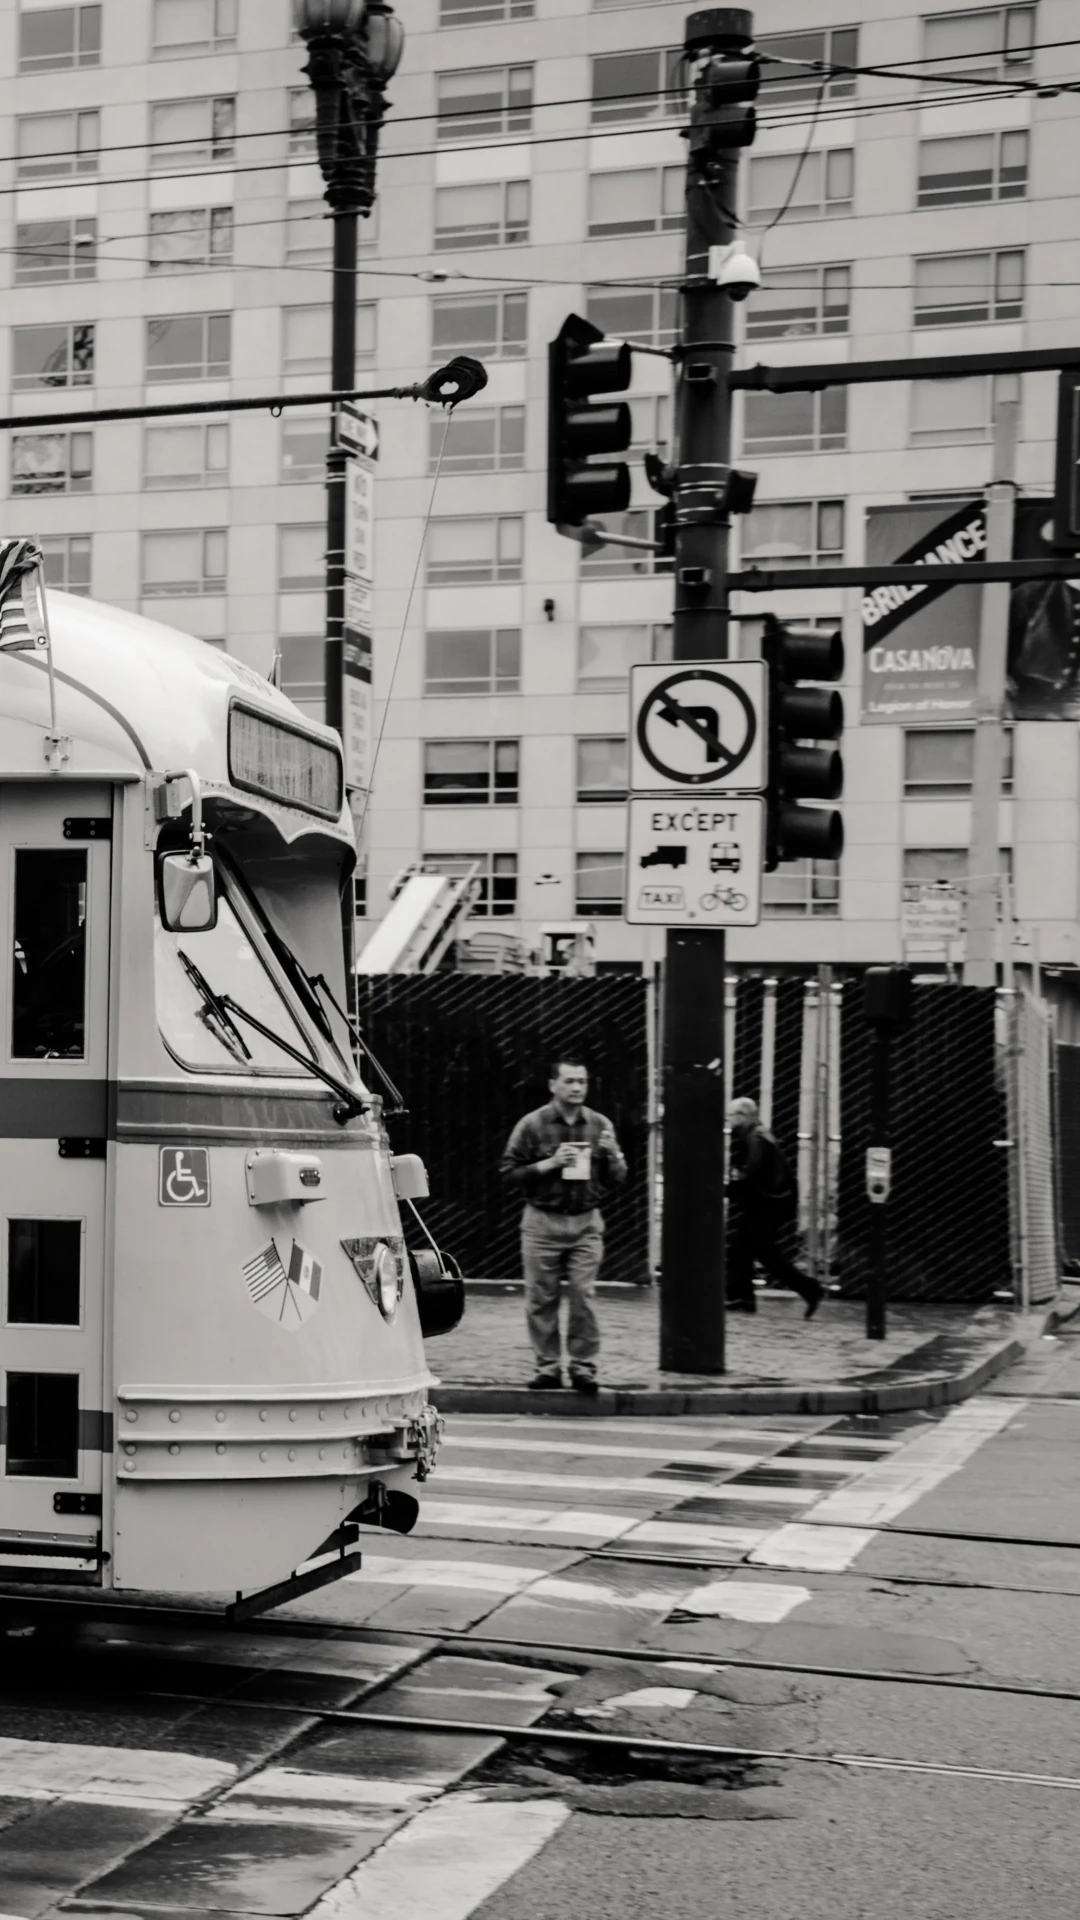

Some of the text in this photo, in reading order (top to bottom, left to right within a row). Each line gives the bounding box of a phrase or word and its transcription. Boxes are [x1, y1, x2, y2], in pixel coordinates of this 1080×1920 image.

[861, 519, 987, 626] BRILANCE
[869, 646, 975, 673] CASANOVA
[652, 813, 738, 831] EXCEPT
[643, 892, 681, 904] TAXI
